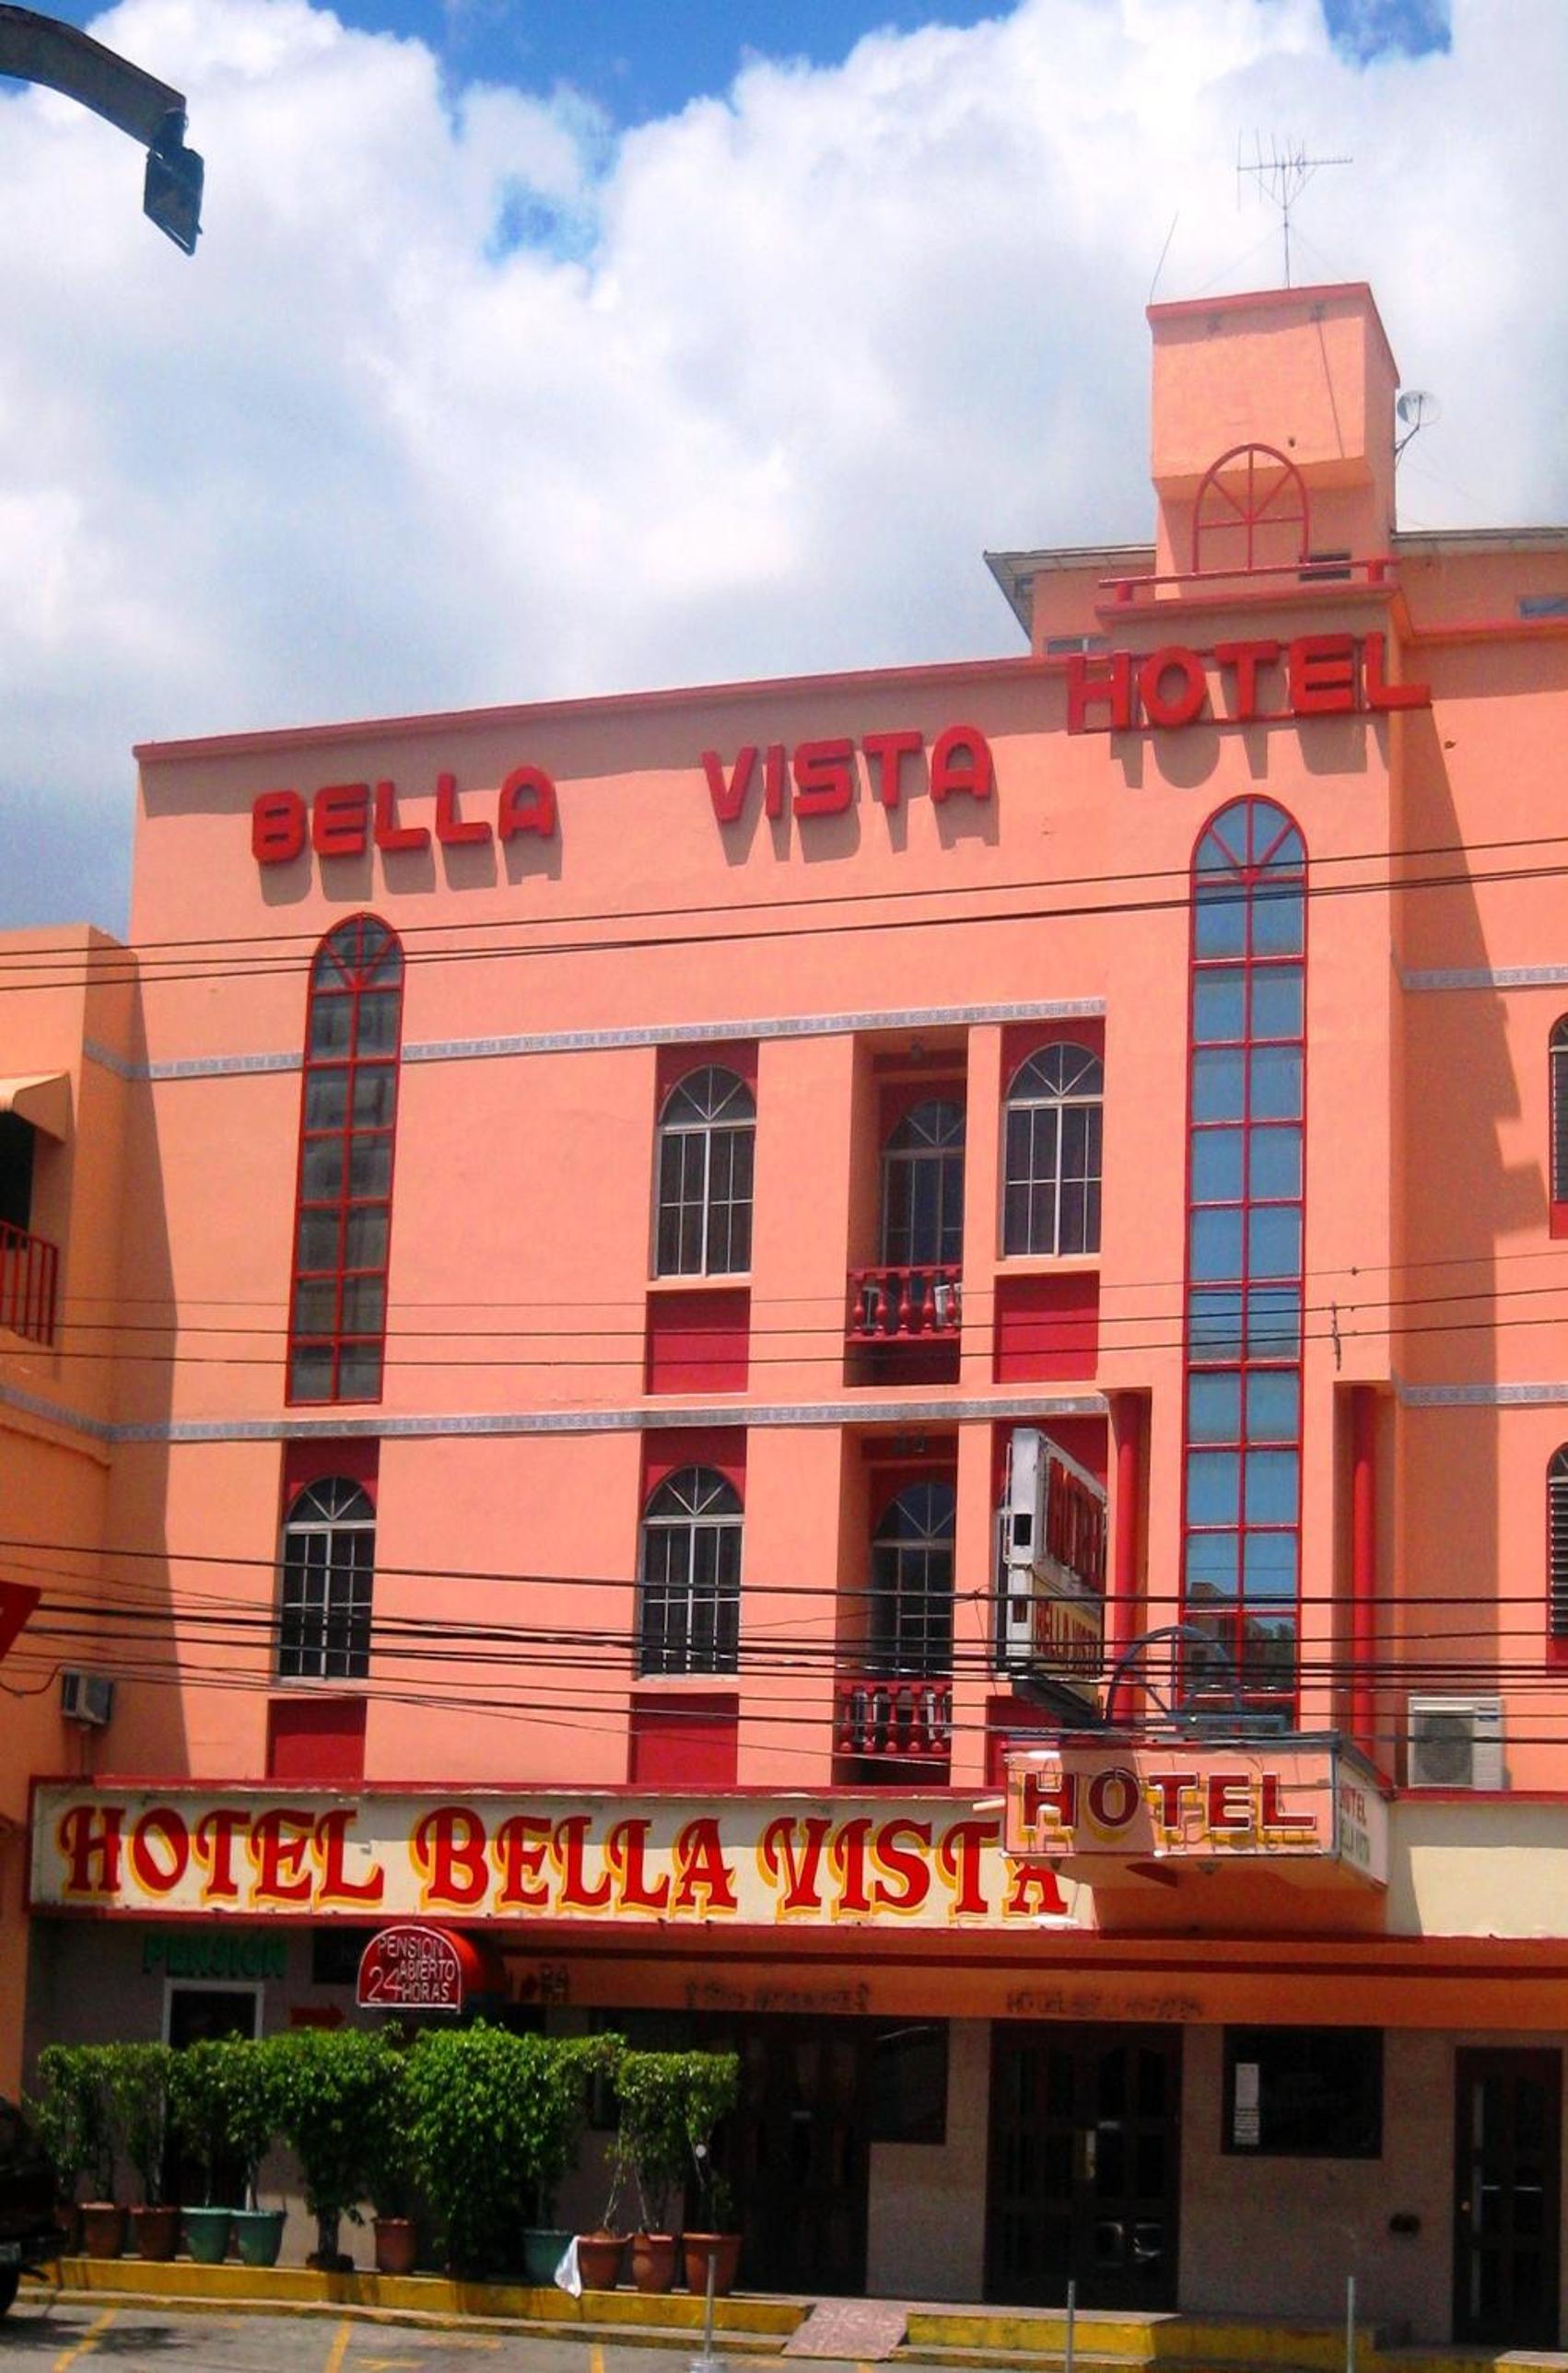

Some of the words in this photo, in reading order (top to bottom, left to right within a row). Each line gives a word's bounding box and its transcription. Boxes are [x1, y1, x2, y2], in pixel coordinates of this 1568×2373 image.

[1066, 631, 1433, 736] HOTEL
[252, 765, 554, 863] BELLA
[701, 724, 992, 824] VISTA
[1023, 1766, 1316, 1832] HOTEL
[60, 1806, 385, 1909] HOTEL
[413, 1806, 738, 1912] BELLA
[377, 1935, 445, 1959] PENSION
[399, 1958, 456, 1982] ABIERTO
[367, 1965, 404, 2003] 24
[401, 1981, 451, 2003] HORAS
